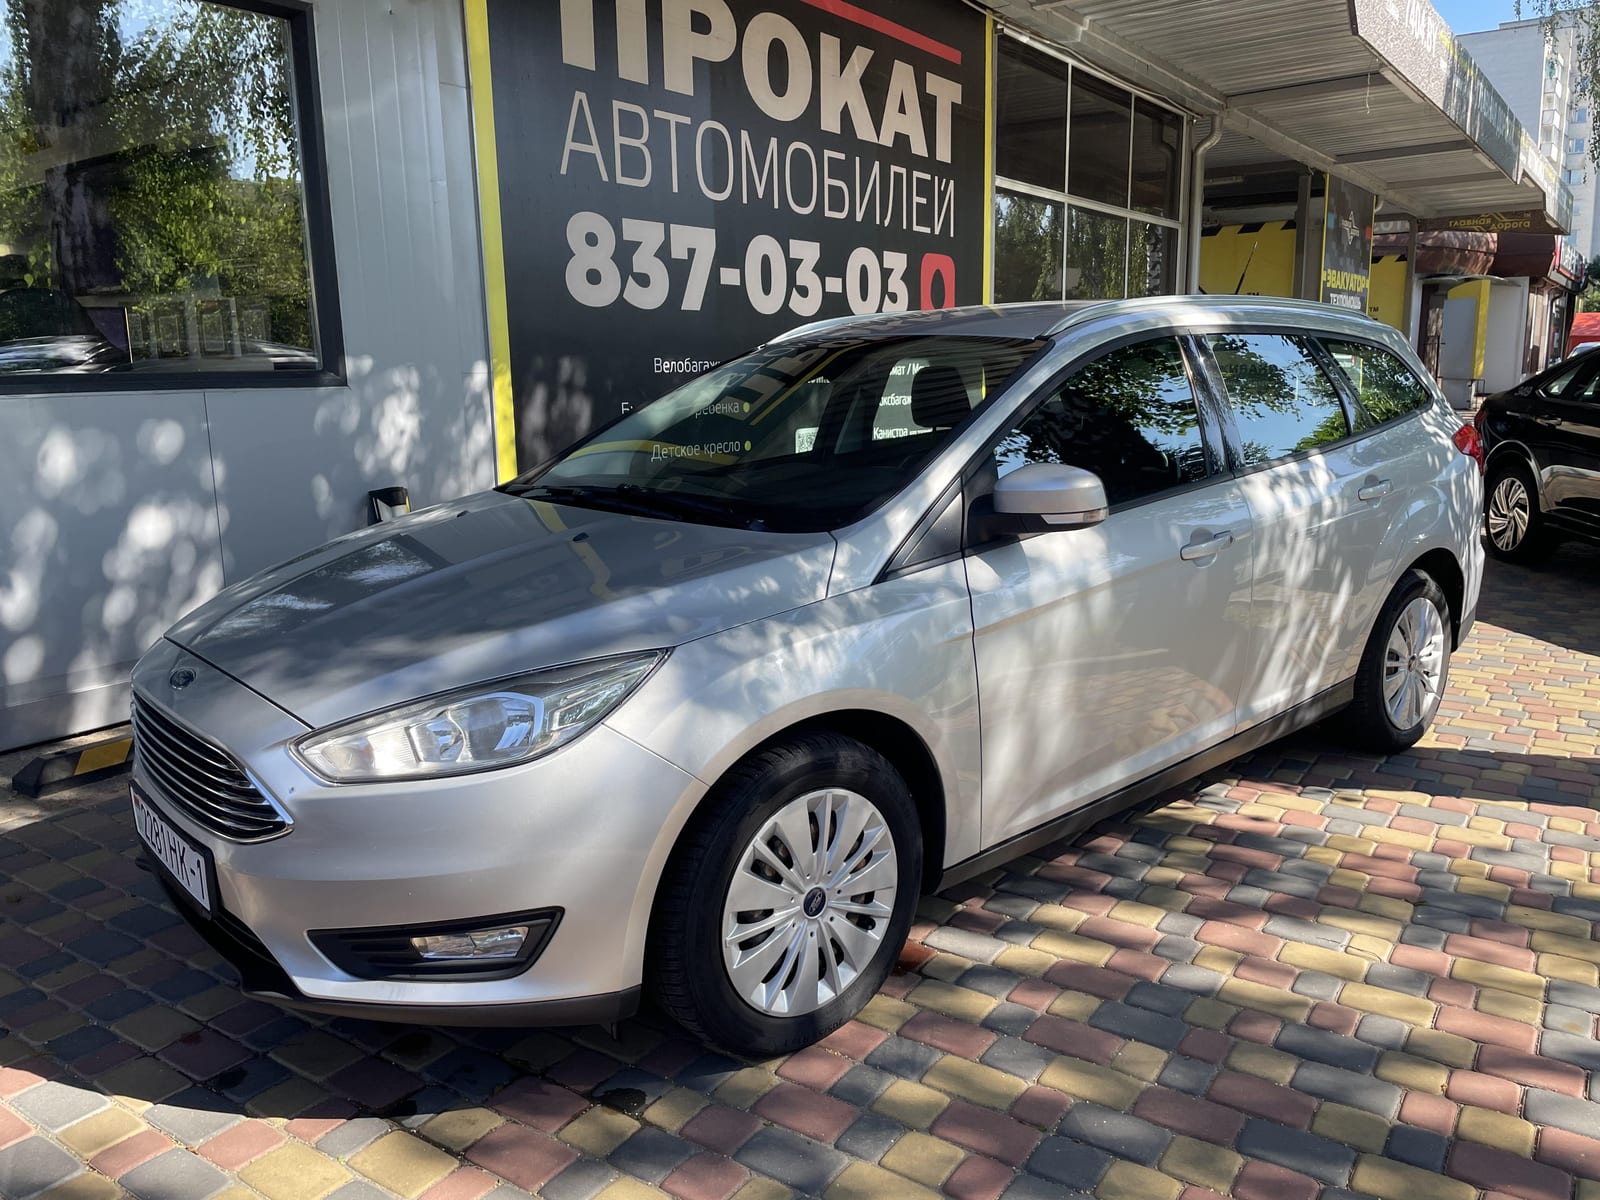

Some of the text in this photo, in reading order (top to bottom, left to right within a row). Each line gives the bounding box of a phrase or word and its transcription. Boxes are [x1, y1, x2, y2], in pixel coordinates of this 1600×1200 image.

[560, 0, 962, 164] ПРОКАТ
[560, 91, 956, 238] АВТОМОБИЛЕЙ
[565, 211, 909, 316] 837-03-03
[654, 357, 721, 373] Велобага
[650, 440, 741, 463] Детское кресло
